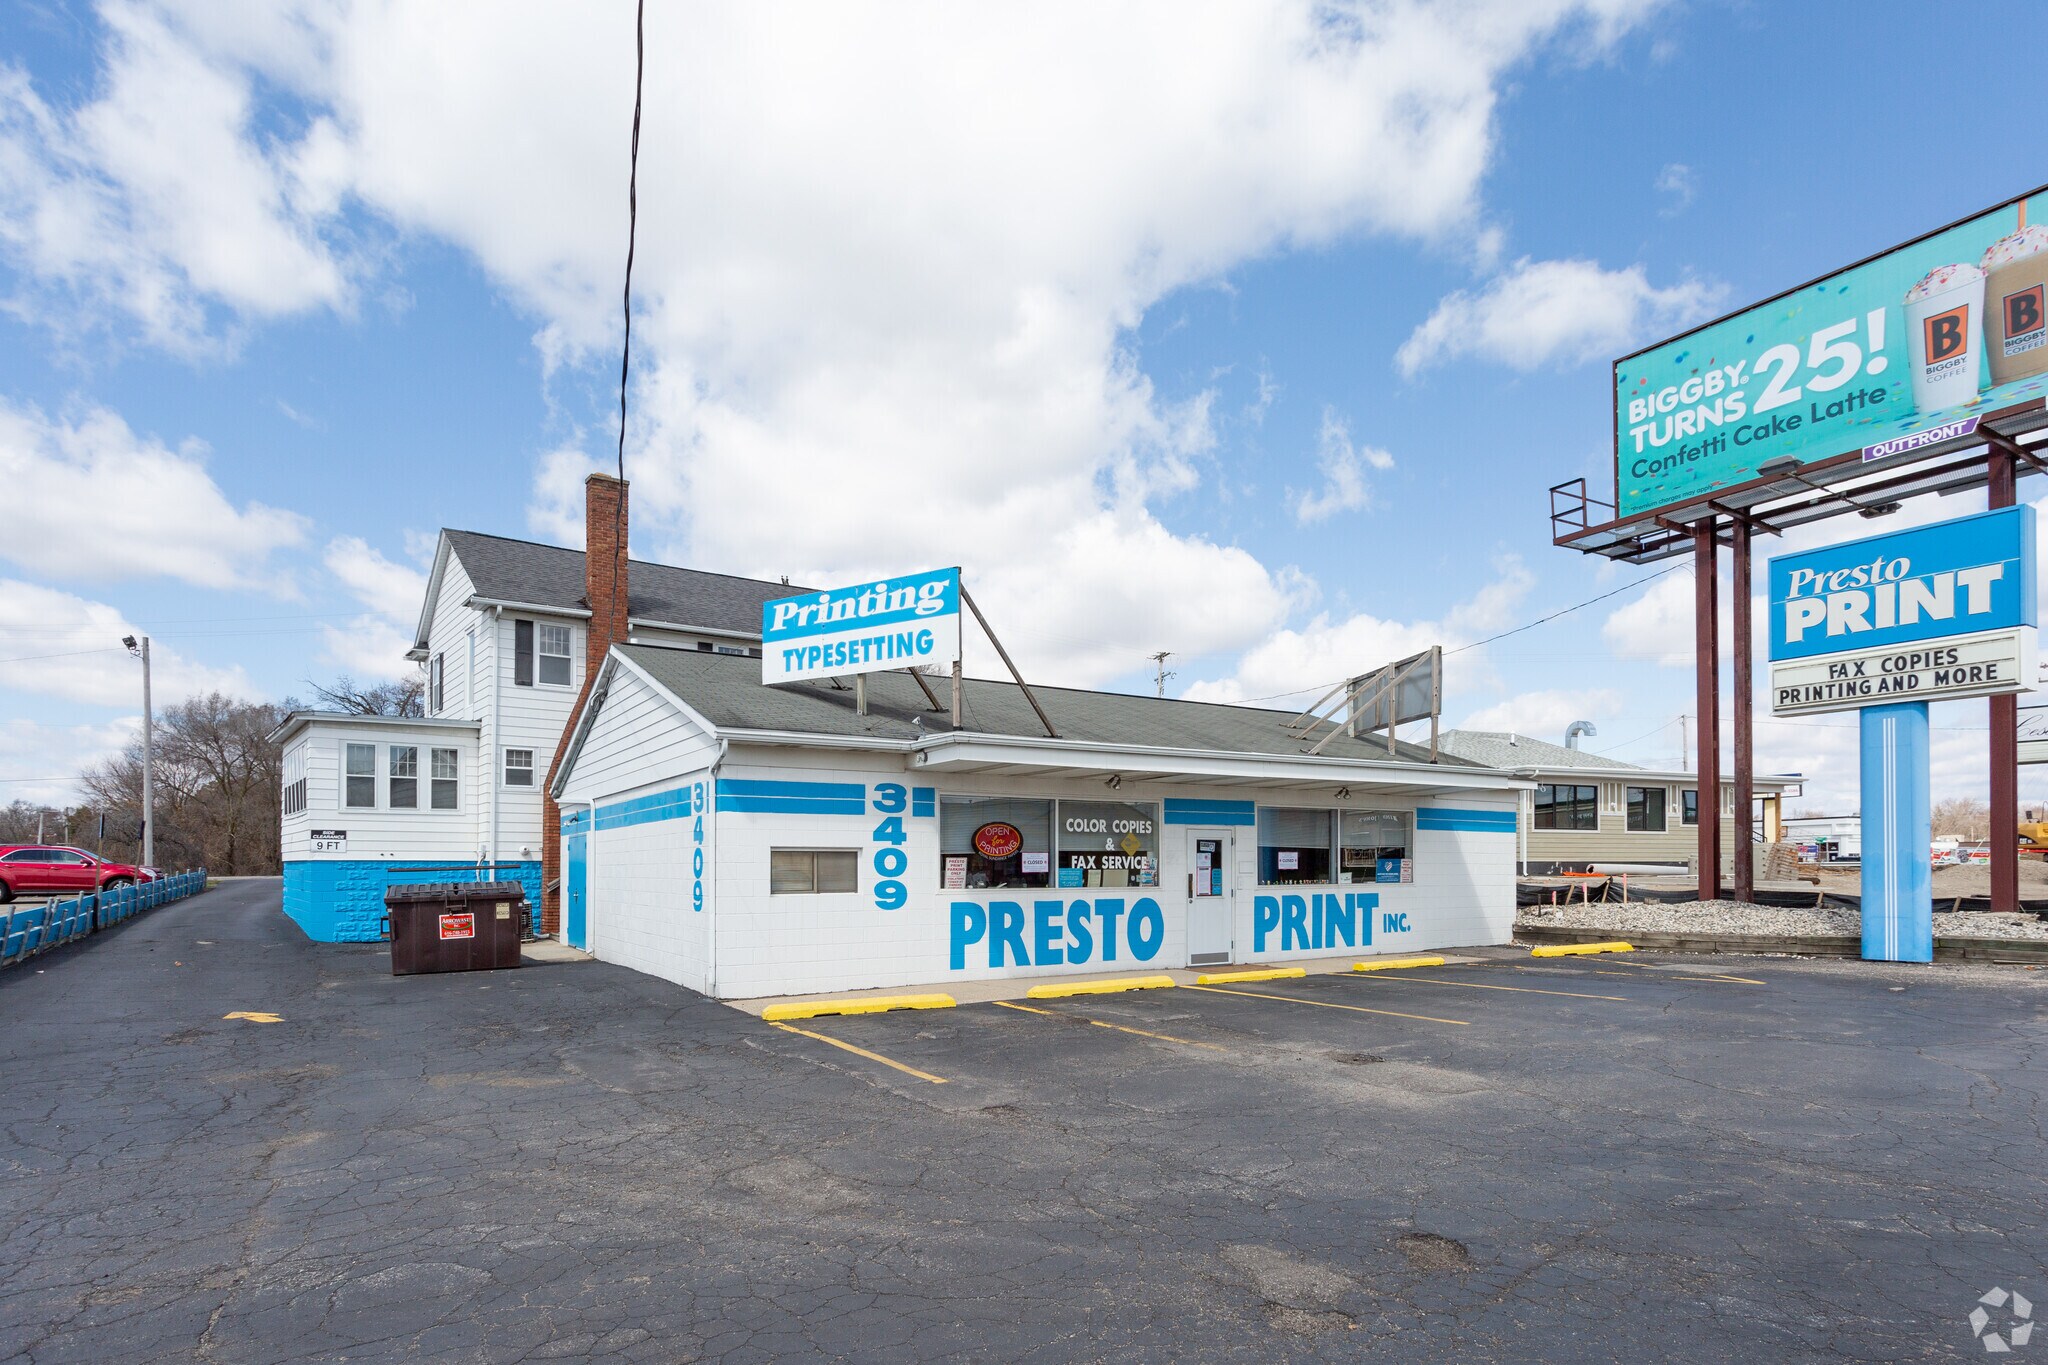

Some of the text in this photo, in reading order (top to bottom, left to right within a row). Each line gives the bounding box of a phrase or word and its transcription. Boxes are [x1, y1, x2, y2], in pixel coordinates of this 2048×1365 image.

[2010, 294, 2039, 334] B
[1932, 315, 1962, 360] B
[2004, 330, 2046, 347] BIGGBY
[2005, 338, 2046, 356] COFFEE
[1753, 307, 1888, 415] 25!
[1926, 356, 1968, 375] BIGGBY
[1926, 367, 1967, 384] COFFEE
[1629, 391, 1747, 453] TURNS
[1631, 388, 1887, 479] Confetti Cake Latte
[1872, 421, 1967, 457] OUTFRONT
[1658, 494, 1682, 504] charges
[1682, 490, 1695, 498] may
[1785, 555, 1911, 600] Presto
[770, 579, 950, 632] Printing
[1785, 562, 2004, 644] PRINT
[783, 628, 934, 672] TYPESETTING
[1829, 648, 1959, 680] FAX COPIES
[1779, 663, 1998, 704] PRINTING AND MORE
[985, 827, 1010, 836] OPEN
[991, 835, 1004, 847] for
[1066, 818, 1152, 834] COLOR COPIES
[1105, 837, 1115, 851] &
[317, 842, 340, 850] 9 FT
[693, 782, 704, 912] 3409
[873, 783, 908, 911] 3409
[980, 840, 1018, 855] PRINTING
[1071, 855, 1148, 869] FAX SERVICE
[950, 897, 1164, 971] PRESTO
[1254, 892, 1411, 953] PRINT INC.
